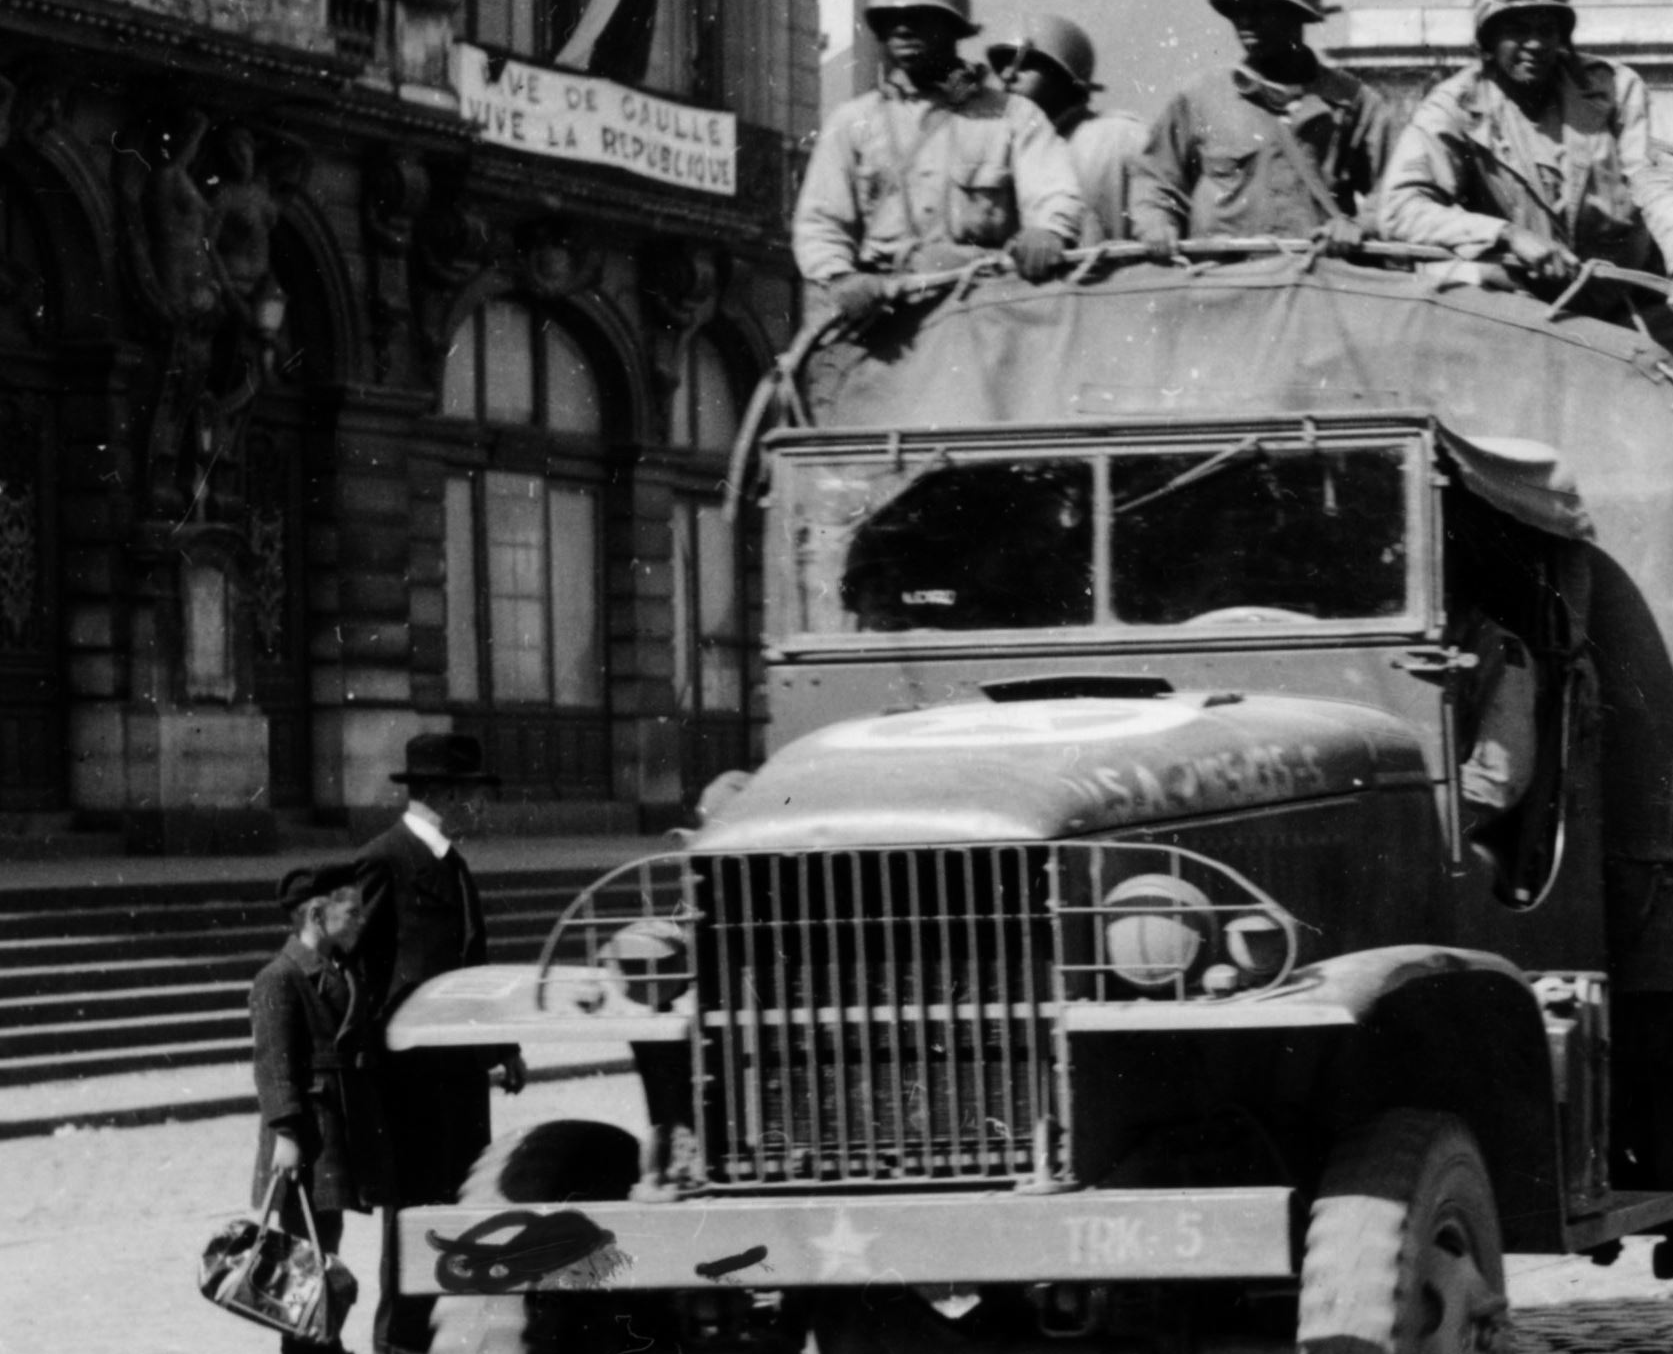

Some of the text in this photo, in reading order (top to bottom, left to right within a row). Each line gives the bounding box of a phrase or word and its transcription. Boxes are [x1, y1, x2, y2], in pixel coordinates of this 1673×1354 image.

[547, 125, 578, 149] LA
[565, 86, 599, 113] DE
[620, 94, 721, 147] GAULLE
